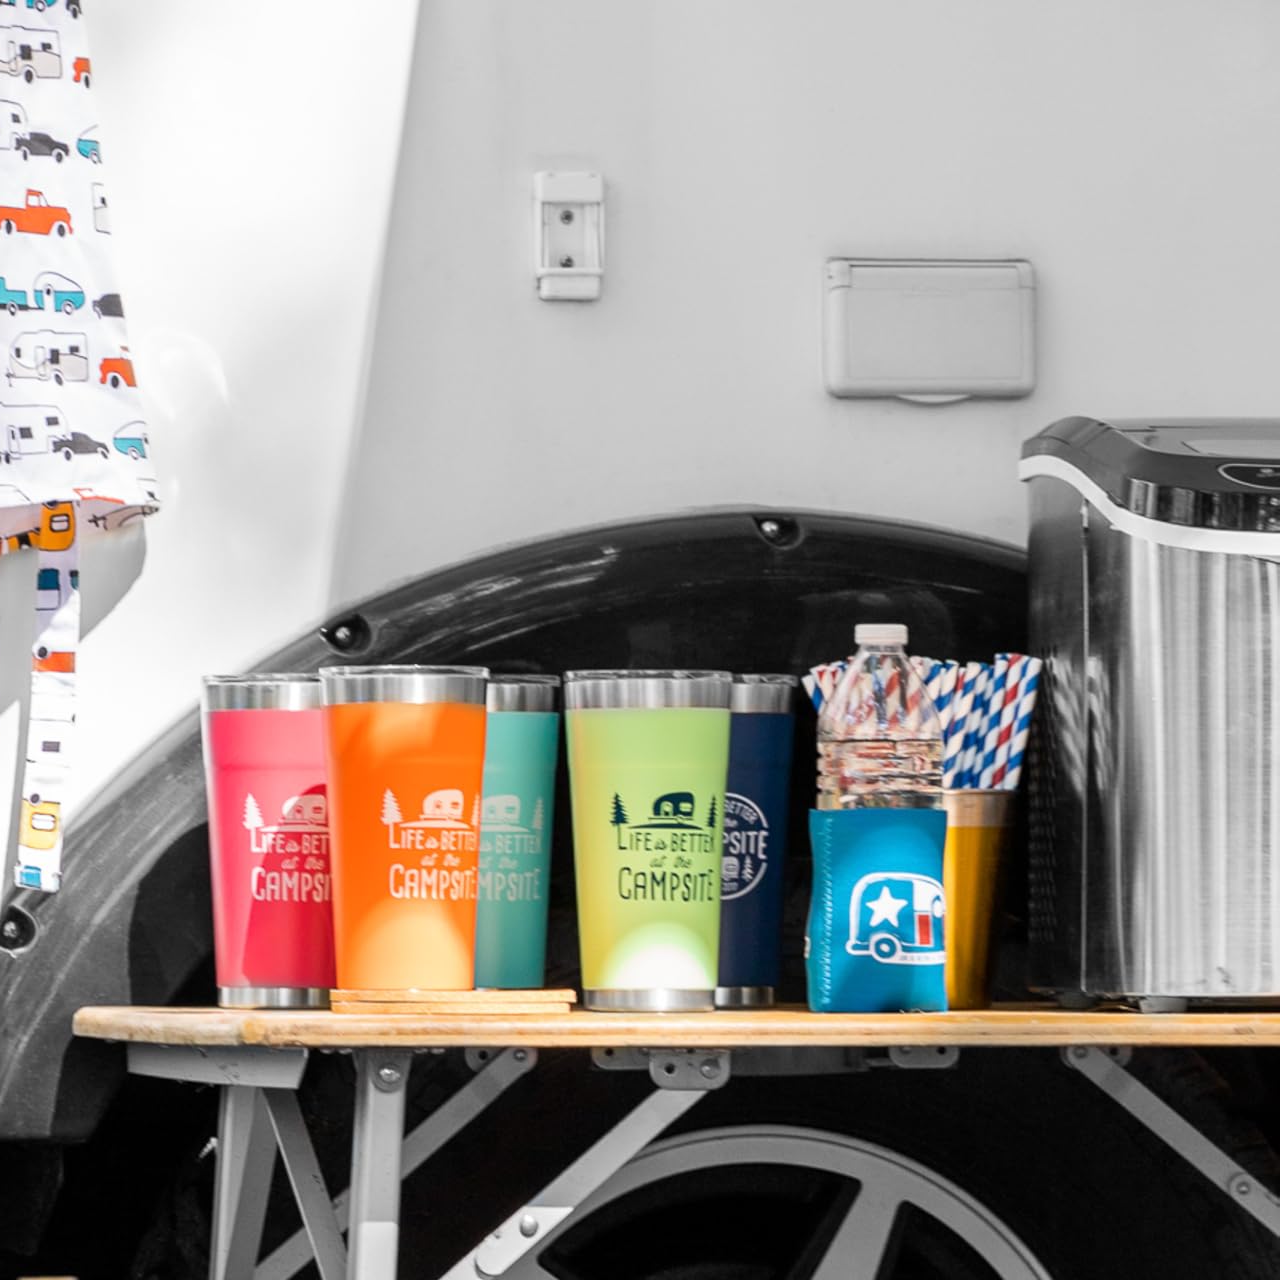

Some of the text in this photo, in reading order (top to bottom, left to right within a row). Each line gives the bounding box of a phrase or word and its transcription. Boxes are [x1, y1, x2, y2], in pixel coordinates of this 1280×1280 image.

[617, 829, 652, 851] LIFE
[251, 866, 330, 903] CAMPSI
[389, 863, 477, 900] CAMPSITE
[479, 867, 542, 902] MPSITE
[618, 866, 714, 902] CAMPSITE
